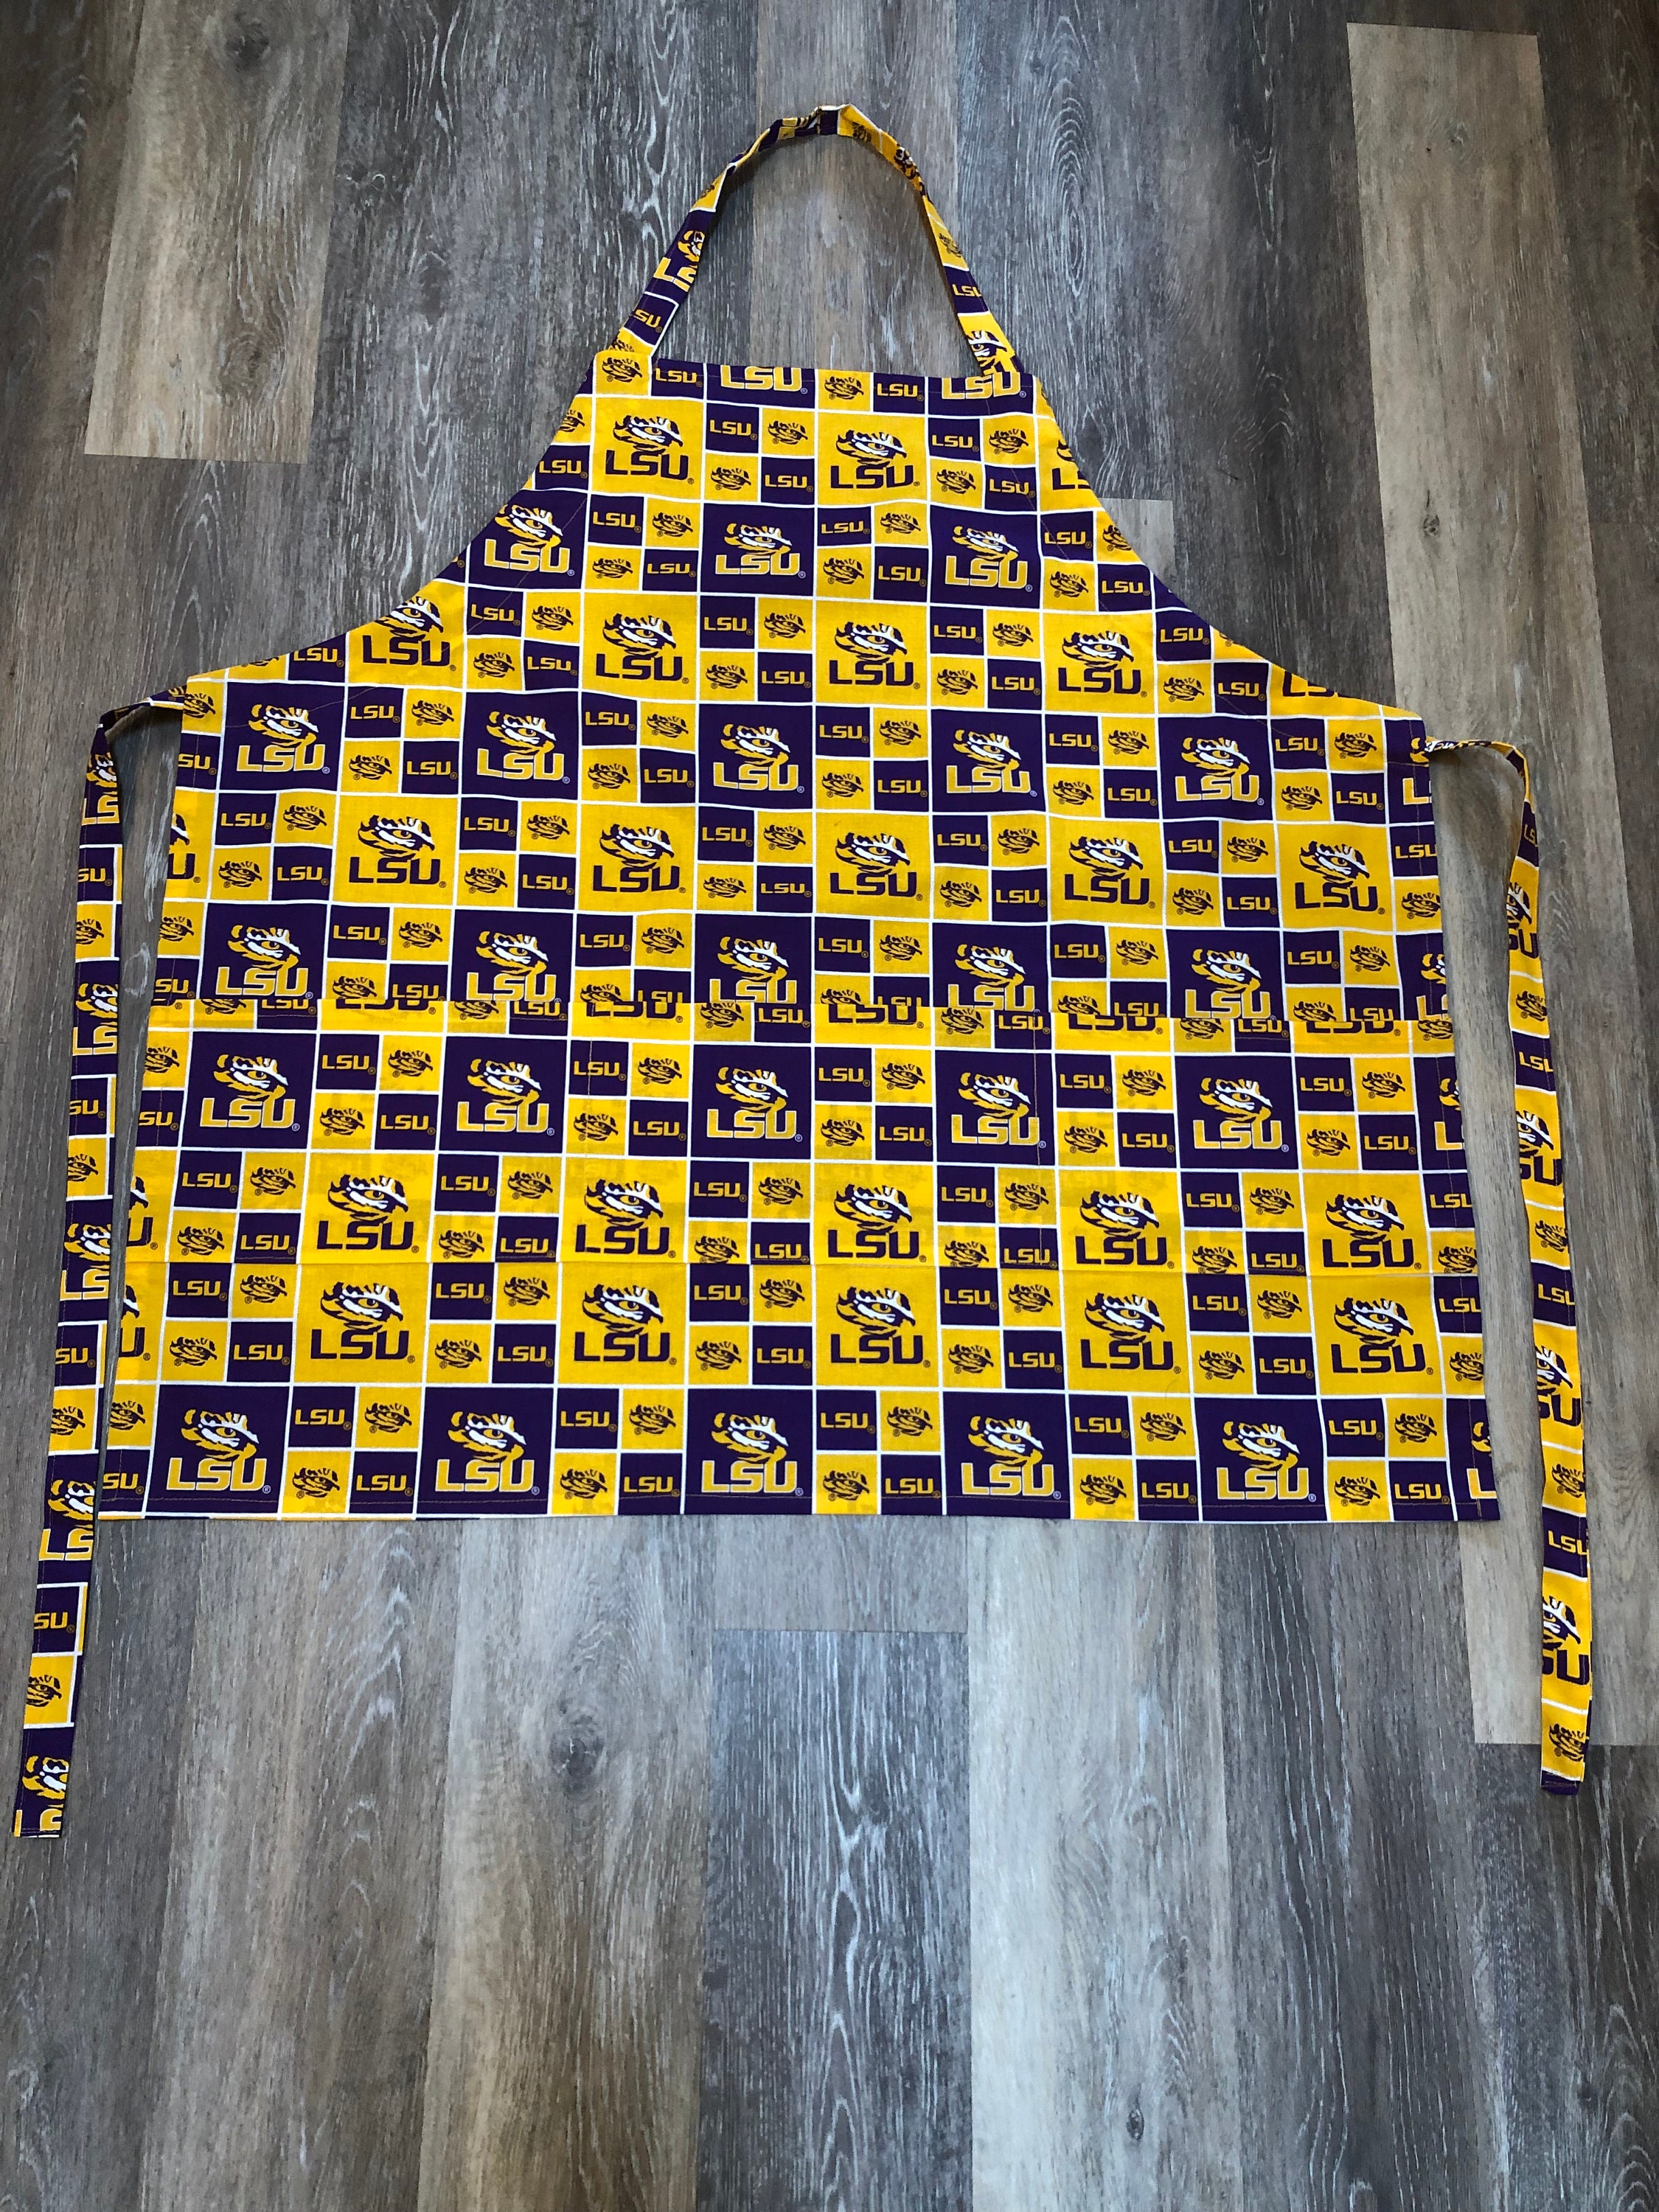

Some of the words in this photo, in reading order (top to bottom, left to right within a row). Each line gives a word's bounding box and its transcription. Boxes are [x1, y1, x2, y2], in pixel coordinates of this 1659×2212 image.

[635, 309, 661, 328] SU
[655, 368, 698, 383] LSU
[721, 365, 802, 392] LSU
[877, 383, 917, 397] LSU
[942, 372, 1021, 400] LSU
[710, 420, 751, 435] LSU
[932, 435, 973, 448] LSU
[540, 460, 581, 473] LSU
[605, 450, 689, 479] LSU
[765, 475, 807, 488] LSU
[830, 465, 915, 490] LSU
[990, 479, 1029, 495] LSU
[593, 512, 636, 528] LSU
[821, 521, 864, 535] LSU
[1045, 532, 1085, 544] LSU
[484, 538, 571, 574] LSU
[647, 562, 690, 574] LSU
[715, 552, 801, 576] LSU
[878, 566, 920, 581] LSU
[945, 555, 1029, 590] LSU
[1102, 581, 1143, 593] LSU
[471, 605, 514, 621] LSU
[704, 617, 746, 631] LSU
[934, 625, 976, 639] LSU
[1161, 628, 1203, 642] LSU
[293, 647, 338, 664] LSU
[361, 635, 451, 667] LSU
[528, 656, 571, 671] LSU
[595, 653, 684, 684] LSU
[762, 671, 804, 684] LSU
[829, 660, 914, 686] LSU
[1059, 664, 1141, 695] LSU
[992, 677, 1034, 690] LSU
[1218, 683, 1259, 696] LSU
[351, 706, 394, 719] LSU
[585, 712, 629, 726] LSU
[820, 725, 862, 739] LSU
[1050, 734, 1091, 747] LSU
[1276, 737, 1317, 751] LSU
[178, 754, 212, 770] SU
[236, 744, 326, 773] LSU
[476, 748, 564, 781] LSU
[407, 761, 451, 775] LSU
[644, 769, 687, 783] LSU
[712, 762, 799, 792] LSU
[946, 765, 1031, 794] LSU
[877, 780, 920, 793] LSU
[1107, 787, 1150, 801] LSU
[1175, 775, 1260, 803] LSU
[1336, 791, 1377, 805] LSU
[221, 813, 266, 826] LSU
[465, 817, 509, 832] LSU
[702, 827, 746, 841] LSU
[938, 833, 981, 846] LSU
[1169, 839, 1212, 852] LSU
[277, 866, 322, 880] LSU
[348, 856, 441, 885] LSU
[523, 874, 567, 890] LSU
[592, 865, 679, 894] LSU
[830, 872, 917, 897] LSU
[760, 883, 806, 894] LSU
[996, 889, 1040, 902] LSU
[1064, 874, 1150, 905] LSU
[1227, 897, 1270, 910] LSU
[1295, 883, 1378, 912] LSU
[333, 925, 380, 940] LSU
[580, 934, 624, 947] LSU
[818, 938, 861, 953] LSU
[1054, 944, 1099, 958] LSU
[1287, 951, 1332, 964] LSU
[154, 978, 189, 994] SU
[216, 967, 308, 996] LSU
[467, 973, 557, 1002] LSU
[392, 984, 439, 998] LSU
[709, 978, 797, 1004] LSU
[948, 984, 1035, 1011] LSU
[514, 1001, 561, 1016] LSU
[1114, 1001, 1159, 1017] LSU
[1184, 990, 1271, 1020] LSU
[759, 1008, 802, 1023] LSU
[1350, 1007, 1394, 1021] LSU
[998, 1015, 1044, 1031] LSU
[1238, 1019, 1281, 1032] LSU
[322, 1055, 369, 1069] LSU
[574, 1061, 619, 1076] LSU
[818, 1068, 863, 1082] LSU
[1060, 1074, 1105, 1088] LSU
[1301, 1078, 1343, 1091] LSU
[139, 1111, 173, 1126] SU
[201, 1098, 295, 1129] LSU
[456, 1101, 549, 1133] LSU
[380, 1115, 428, 1130] LSU
[633, 1121, 679, 1135] LSU
[707, 1109, 796, 1139] LSU
[951, 1114, 1040, 1145] LSU
[880, 1127, 925, 1141] LSU
[1122, 1133, 1167, 1147] LSU
[1193, 1119, 1282, 1150] LSU
[1364, 1135, 1408, 1150] LSU
[182, 1172, 231, 1187] LSU
[441, 1176, 488, 1191] LSU
[694, 1183, 740, 1197] LSU
[942, 1187, 987, 1202] LSU
[1186, 1193, 1231, 1208] LSU
[240, 1235, 289, 1250] LSU
[317, 1220, 413, 1250] LSU
[575, 1225, 669, 1255] LSU
[501, 1238, 549, 1253] LSU
[755, 1244, 801, 1259] LSU
[827, 1229, 919, 1259] LSU
[1076, 1236, 1167, 1266] LSU
[1004, 1248, 1051, 1265] LSU
[1252, 1253, 1297, 1268] LSU
[1322, 1239, 1413, 1268] LSU
[173, 1281, 220, 1295] LSU
[436, 1283, 484, 1298] LSU
[695, 1285, 740, 1300] LSU
[945, 1289, 990, 1304] LSU
[1193, 1295, 1239, 1311] LSU
[310, 1329, 408, 1360] LSU
[574, 1332, 669, 1363] LSU
[830, 1335, 923, 1364] LSU
[55, 1348, 88, 1365] SU
[234, 1345, 283, 1360] LSU
[498, 1346, 546, 1361] LSU
[757, 1348, 804, 1363] LSU
[1009, 1352, 1054, 1367] LSU
[1081, 1339, 1173, 1371] LSU
[1331, 1343, 1425, 1374] LSU
[1259, 1358, 1306, 1373] LSU
[295, 1410, 345, 1425] LSU
[561, 1411, 609, 1426] LSU
[821, 1413, 868, 1428] LSU
[1075, 1417, 1121, 1433] LSU
[1329, 1420, 1376, 1435] LSU
[102, 1473, 138, 1490] SU
[166, 1458, 268, 1491] LSU
[435, 1458, 535, 1492] LSU
[702, 1460, 797, 1494] LSU
[961, 1462, 1054, 1497] LSU
[357, 1475, 406, 1491] LSU
[624, 1477, 672, 1492] LSU
[886, 1478, 933, 1494] LSU
[1141, 1483, 1189, 1498] LSU
[1217, 1467, 1309, 1500] LSU
[1395, 1484, 1441, 1499] LSU
